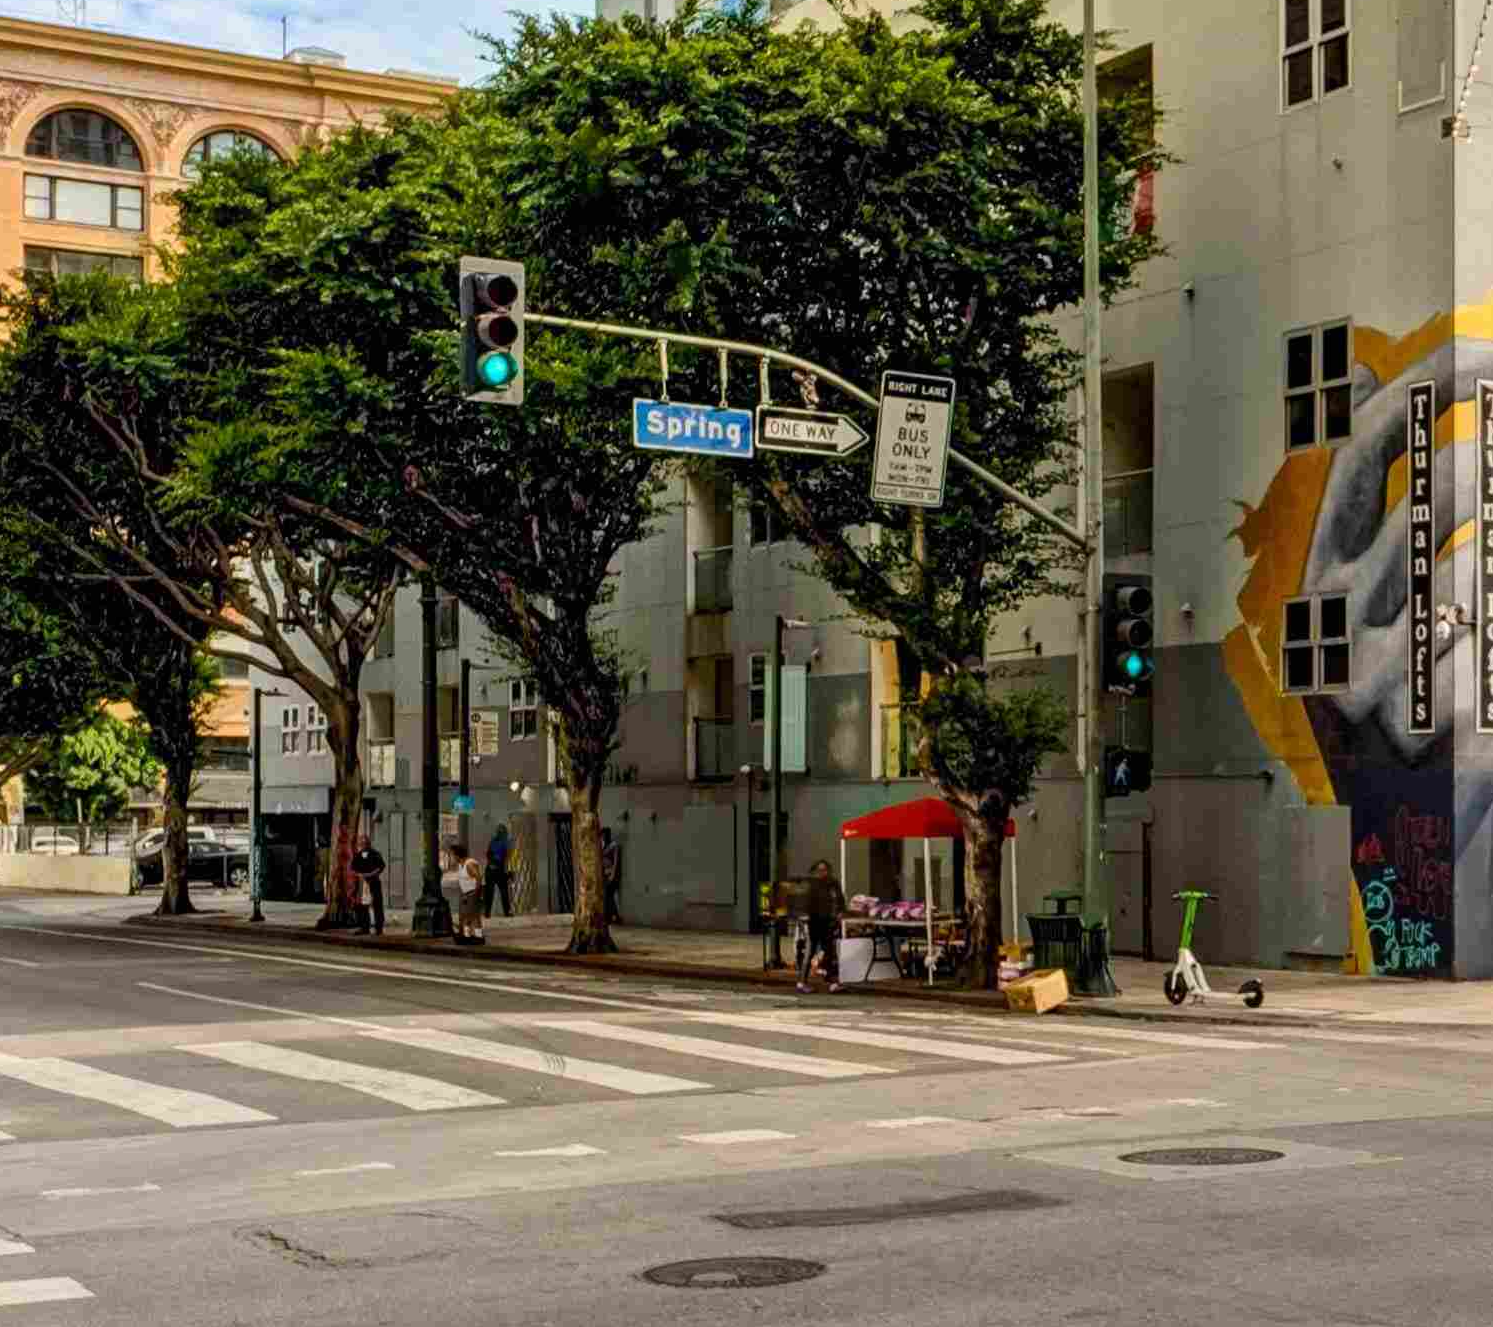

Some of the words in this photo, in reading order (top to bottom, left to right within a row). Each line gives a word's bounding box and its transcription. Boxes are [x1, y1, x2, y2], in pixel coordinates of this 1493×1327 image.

[646, 410, 742, 448] Spring
[770, 420, 799, 437] ONE
[806, 423, 837, 441] WAY
[898, 427, 929, 444] BUS
[892, 442, 932, 459] ONLY
[1411, 394, 1430, 575] Thurman
[1414, 594, 1428, 721] Lofts
